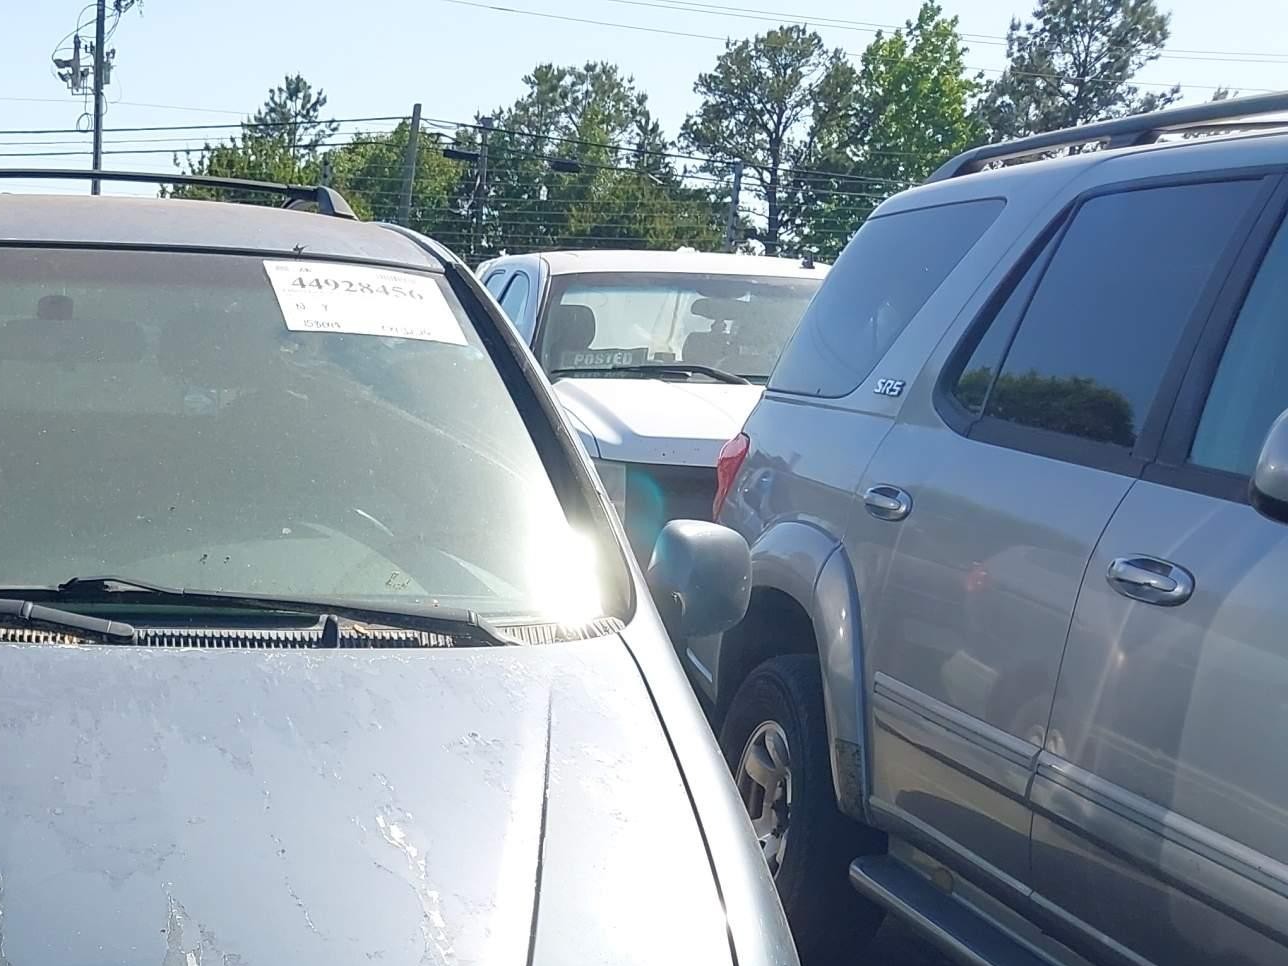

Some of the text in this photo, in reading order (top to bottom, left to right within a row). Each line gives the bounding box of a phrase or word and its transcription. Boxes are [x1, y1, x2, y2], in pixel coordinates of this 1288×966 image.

[290, 276, 425, 301] 44928456
[573, 351, 633, 366] POSTED
[873, 378, 906, 397] SR5
